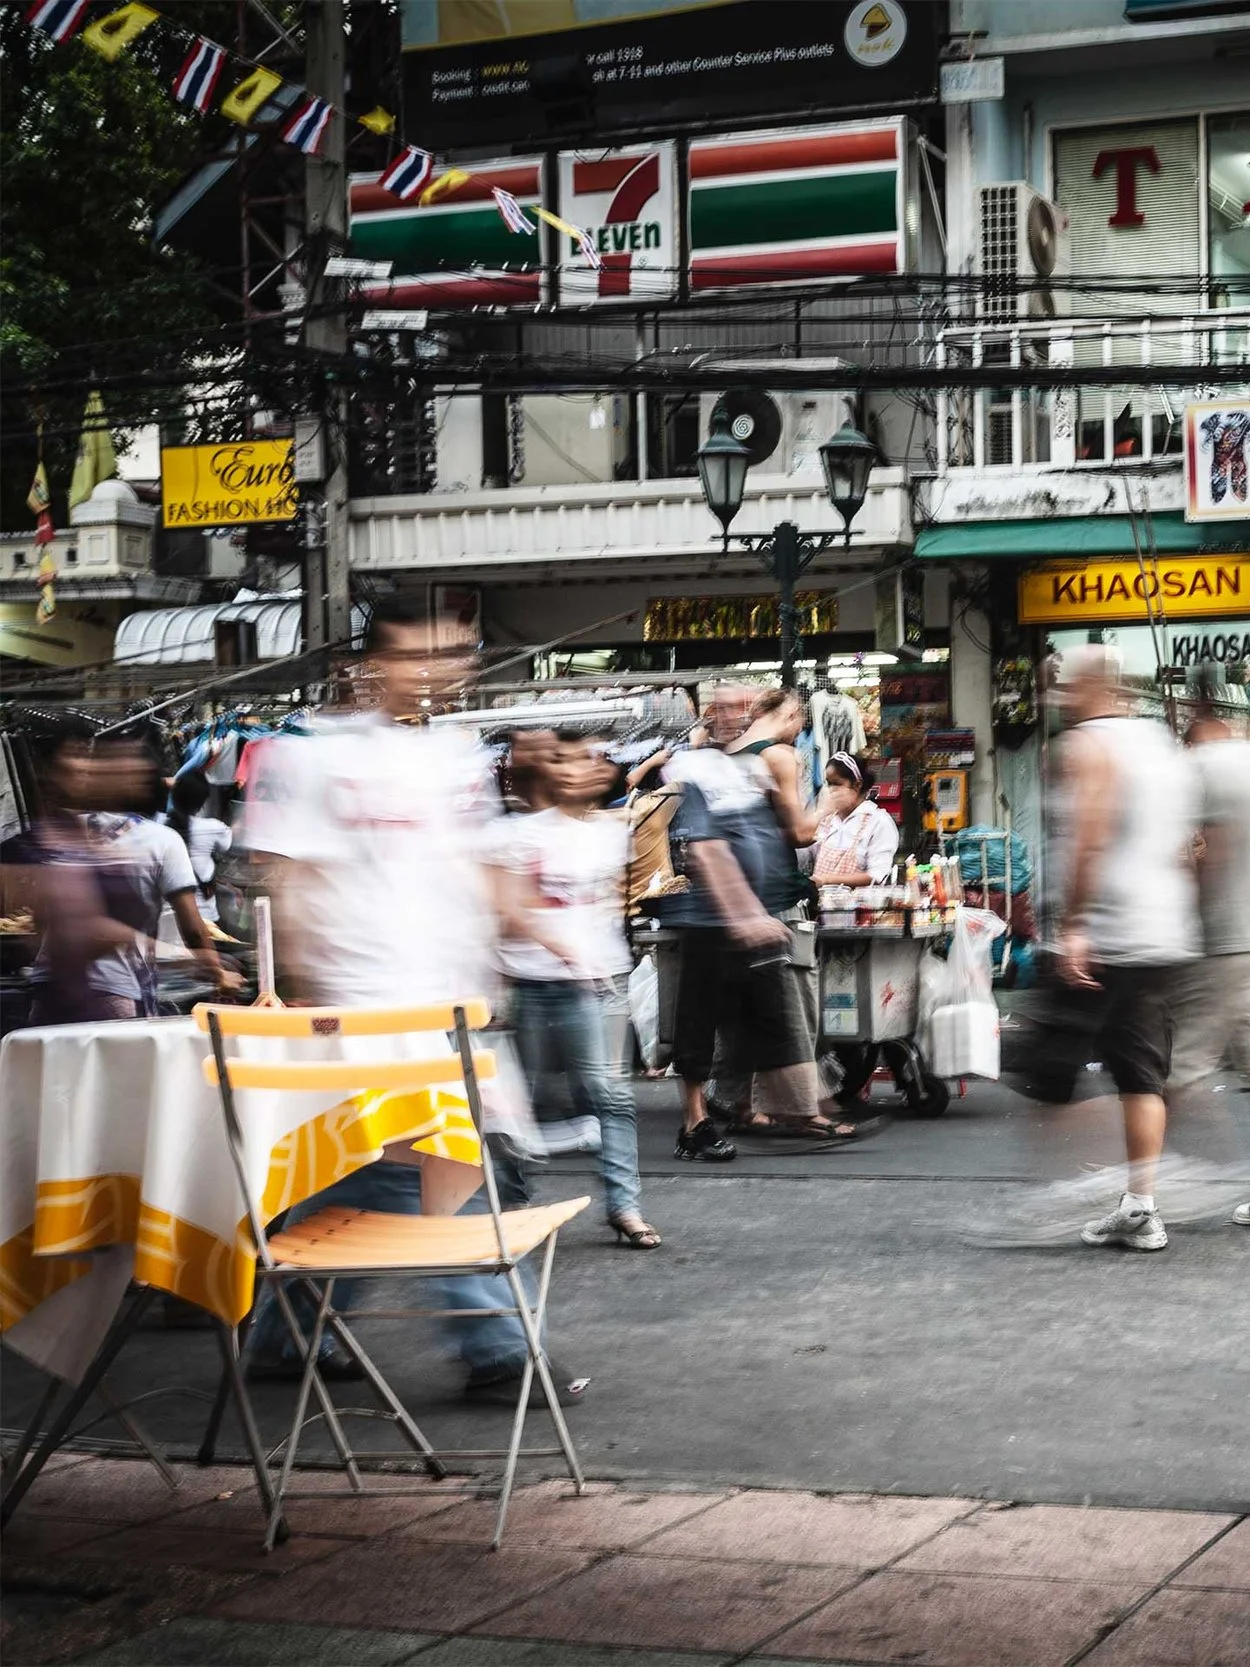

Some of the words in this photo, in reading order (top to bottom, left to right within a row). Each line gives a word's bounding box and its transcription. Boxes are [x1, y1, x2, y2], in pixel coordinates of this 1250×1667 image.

[643, 62, 664, 77] and
[168, 498, 261, 523] FASHION
[1051, 566, 1241, 606] KHAOSAN
